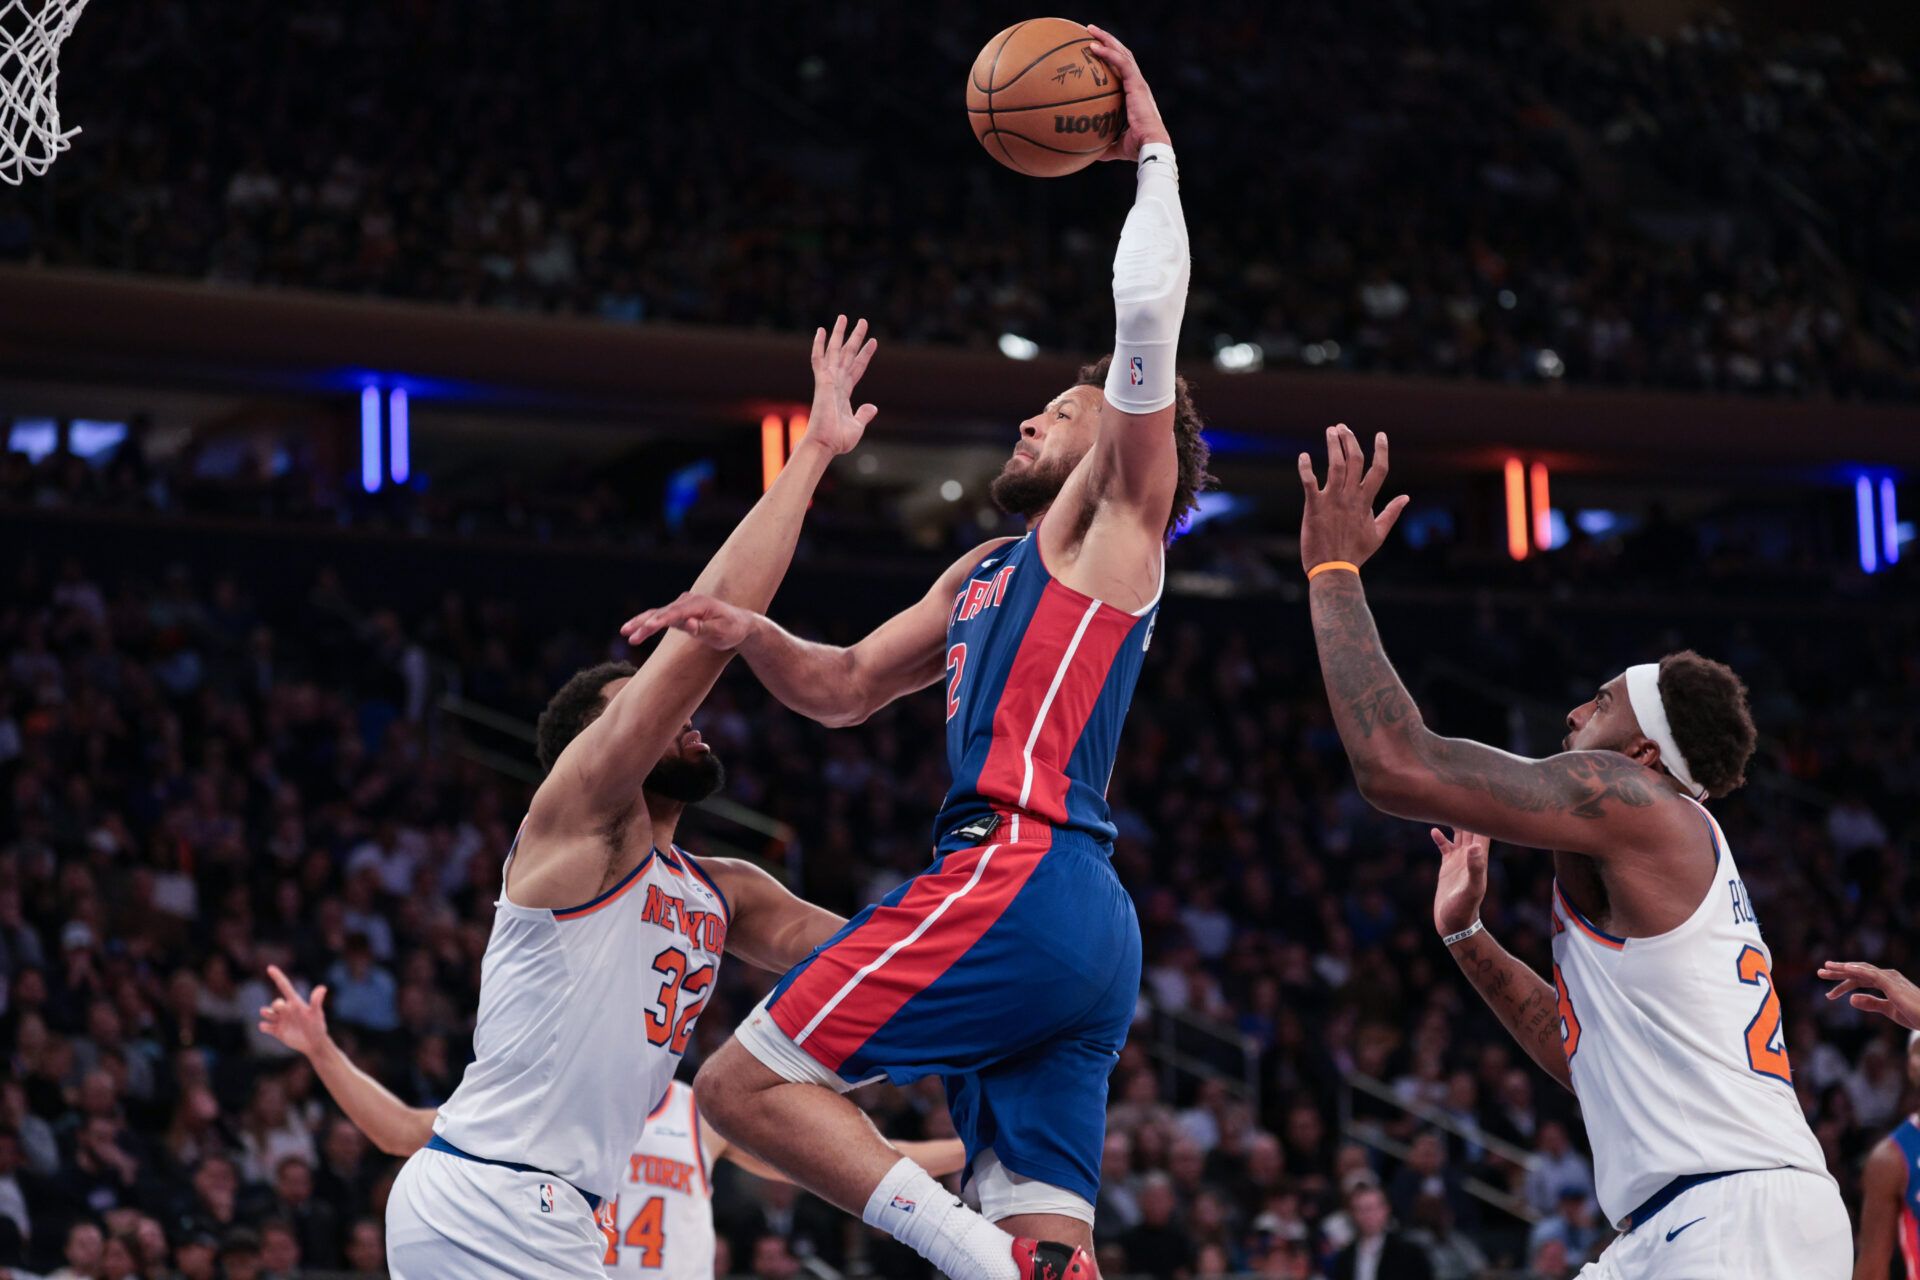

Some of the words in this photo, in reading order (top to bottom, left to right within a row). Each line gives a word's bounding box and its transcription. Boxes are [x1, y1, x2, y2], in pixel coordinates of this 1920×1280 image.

[946, 643, 967, 724] 2
[643, 946, 715, 1056] 32
[630, 1153, 695, 1196] YORK
